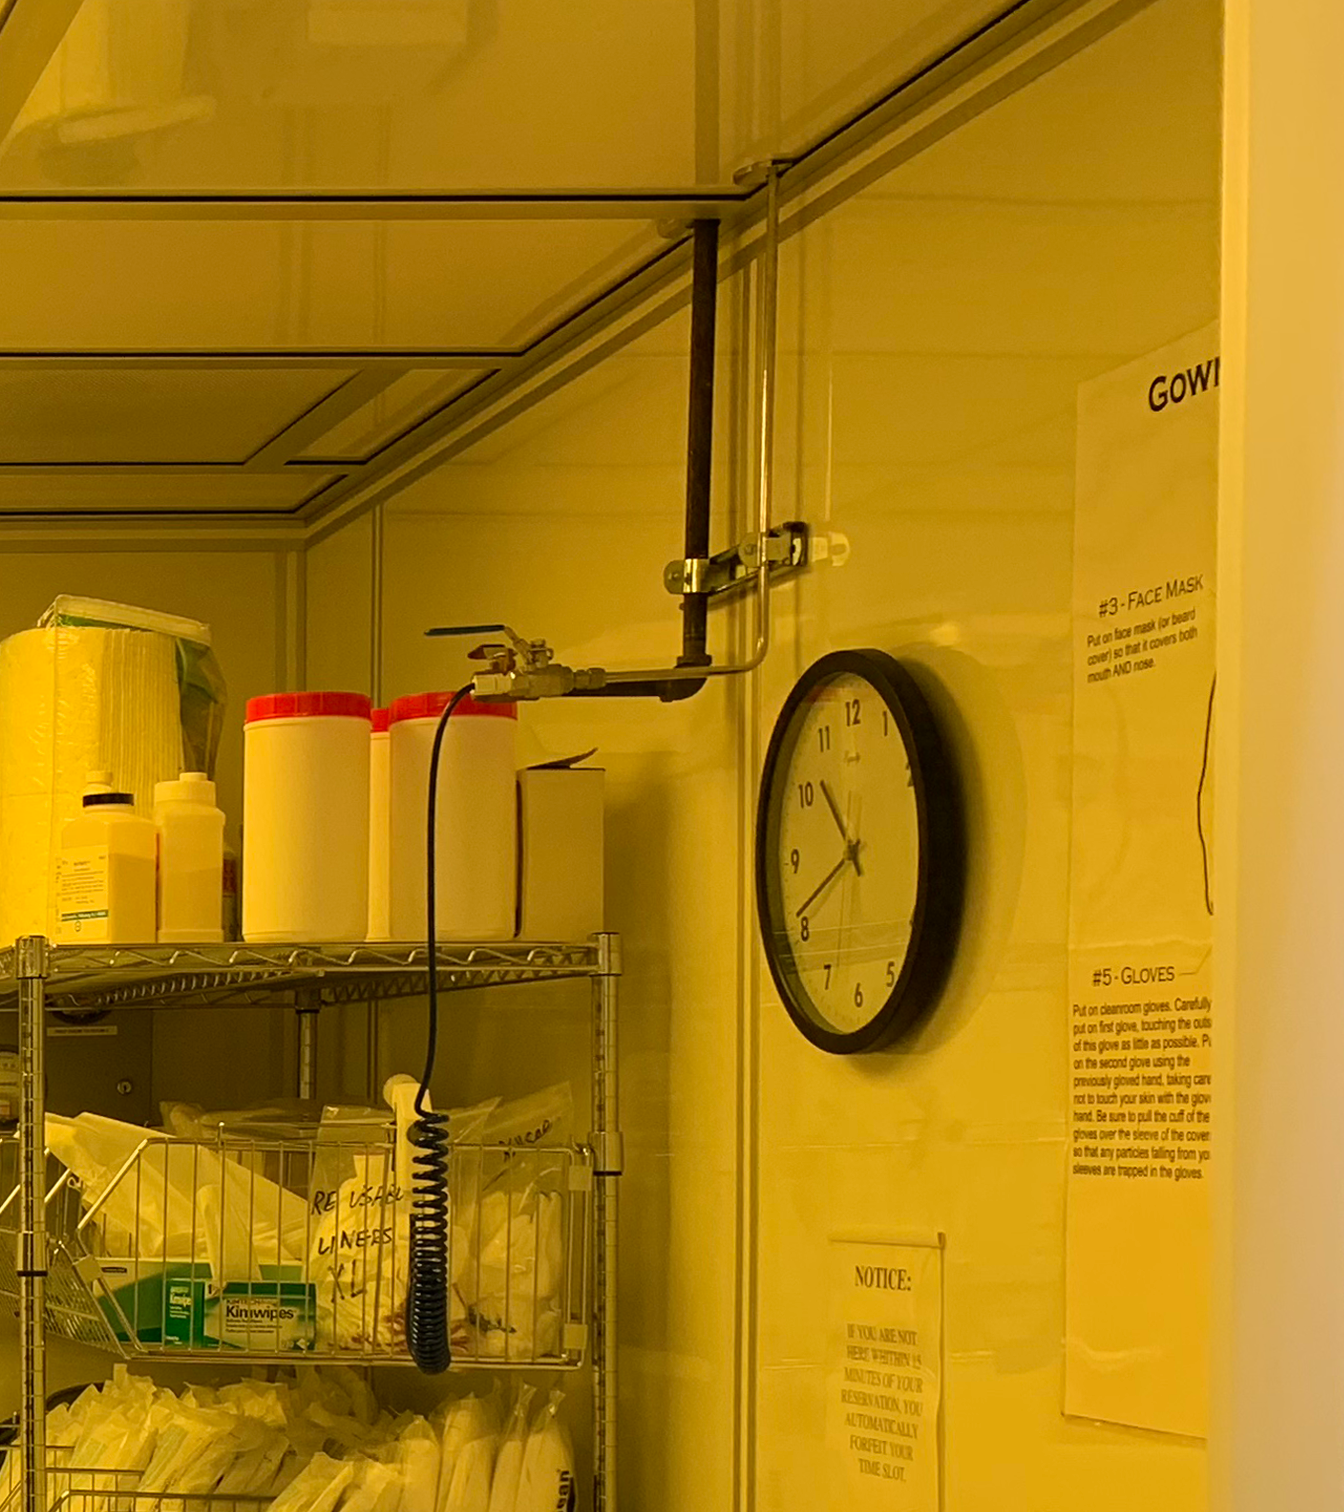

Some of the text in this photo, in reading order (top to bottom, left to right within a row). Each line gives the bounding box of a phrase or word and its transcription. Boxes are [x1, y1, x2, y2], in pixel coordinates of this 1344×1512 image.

[1148, 357, 1220, 412] GOW
[1098, 574, 1204, 618] #3 FACE MASK
[1086, 607, 1196, 648] Put on face mask (or beard
[1087, 625, 1199, 666] cover) so that it covers both
[1087, 658, 1157, 683] mouth AND nose.
[845, 699, 861, 727] 12
[882, 710, 888, 736] 1
[818, 725, 831, 753] 11
[798, 782, 814, 809] 10
[790, 849, 800, 874] 9
[800, 916, 810, 942] 8
[823, 963, 832, 990] 7
[886, 961, 895, 988] 5
[1092, 965, 1176, 987] #5 GLOVES
[854, 982, 863, 1009] 6
[1100, 996, 1211, 1016] cleanroom gloves. Carefully
[1099, 1020, 1114, 1033] first
[1141, 1018, 1176, 1034] touching
[1083, 1034, 1200, 1055] this glove little possible.
[1098, 1055, 1175, 1072] second glove using
[1073, 1073, 1112, 1090] previously
[1113, 1072, 1140, 1090] gloved
[1166, 1072, 1192, 1089] taking
[1096, 1092, 1118, 1105] touch
[1119, 1094, 1138, 1108] your
[1138, 1091, 1156, 1105] skin
[1157, 1092, 1174, 1105] with
[1108, 1111, 1126, 1123] sure
[1137, 1109, 1153, 1125] pull
[1168, 1109, 1185, 1123] cuff
[1073, 1127, 1210, 1143] gloves over sleeve cover
[1084, 1145, 1197, 1163] that particles falling from
[1072, 1163, 1102, 1176] sleeves
[1117, 1164, 1148, 1179] trapped
[855, 1264, 912, 1292] NOTICE:
[225, 1305, 294, 1322] Kimwipes
[846, 1323, 918, 1346] IF YOU ARE NOT
[846, 1345, 870, 1362] HERE
[844, 1367, 924, 1394] MINUTES OF YOUR
[903, 1399, 924, 1418] YOU
[844, 1412, 919, 1440] AUTOMATICALLY
[849, 1434, 914, 1461] FORFEIT YOUR
[858, 1457, 907, 1483] TIME SLOT.
